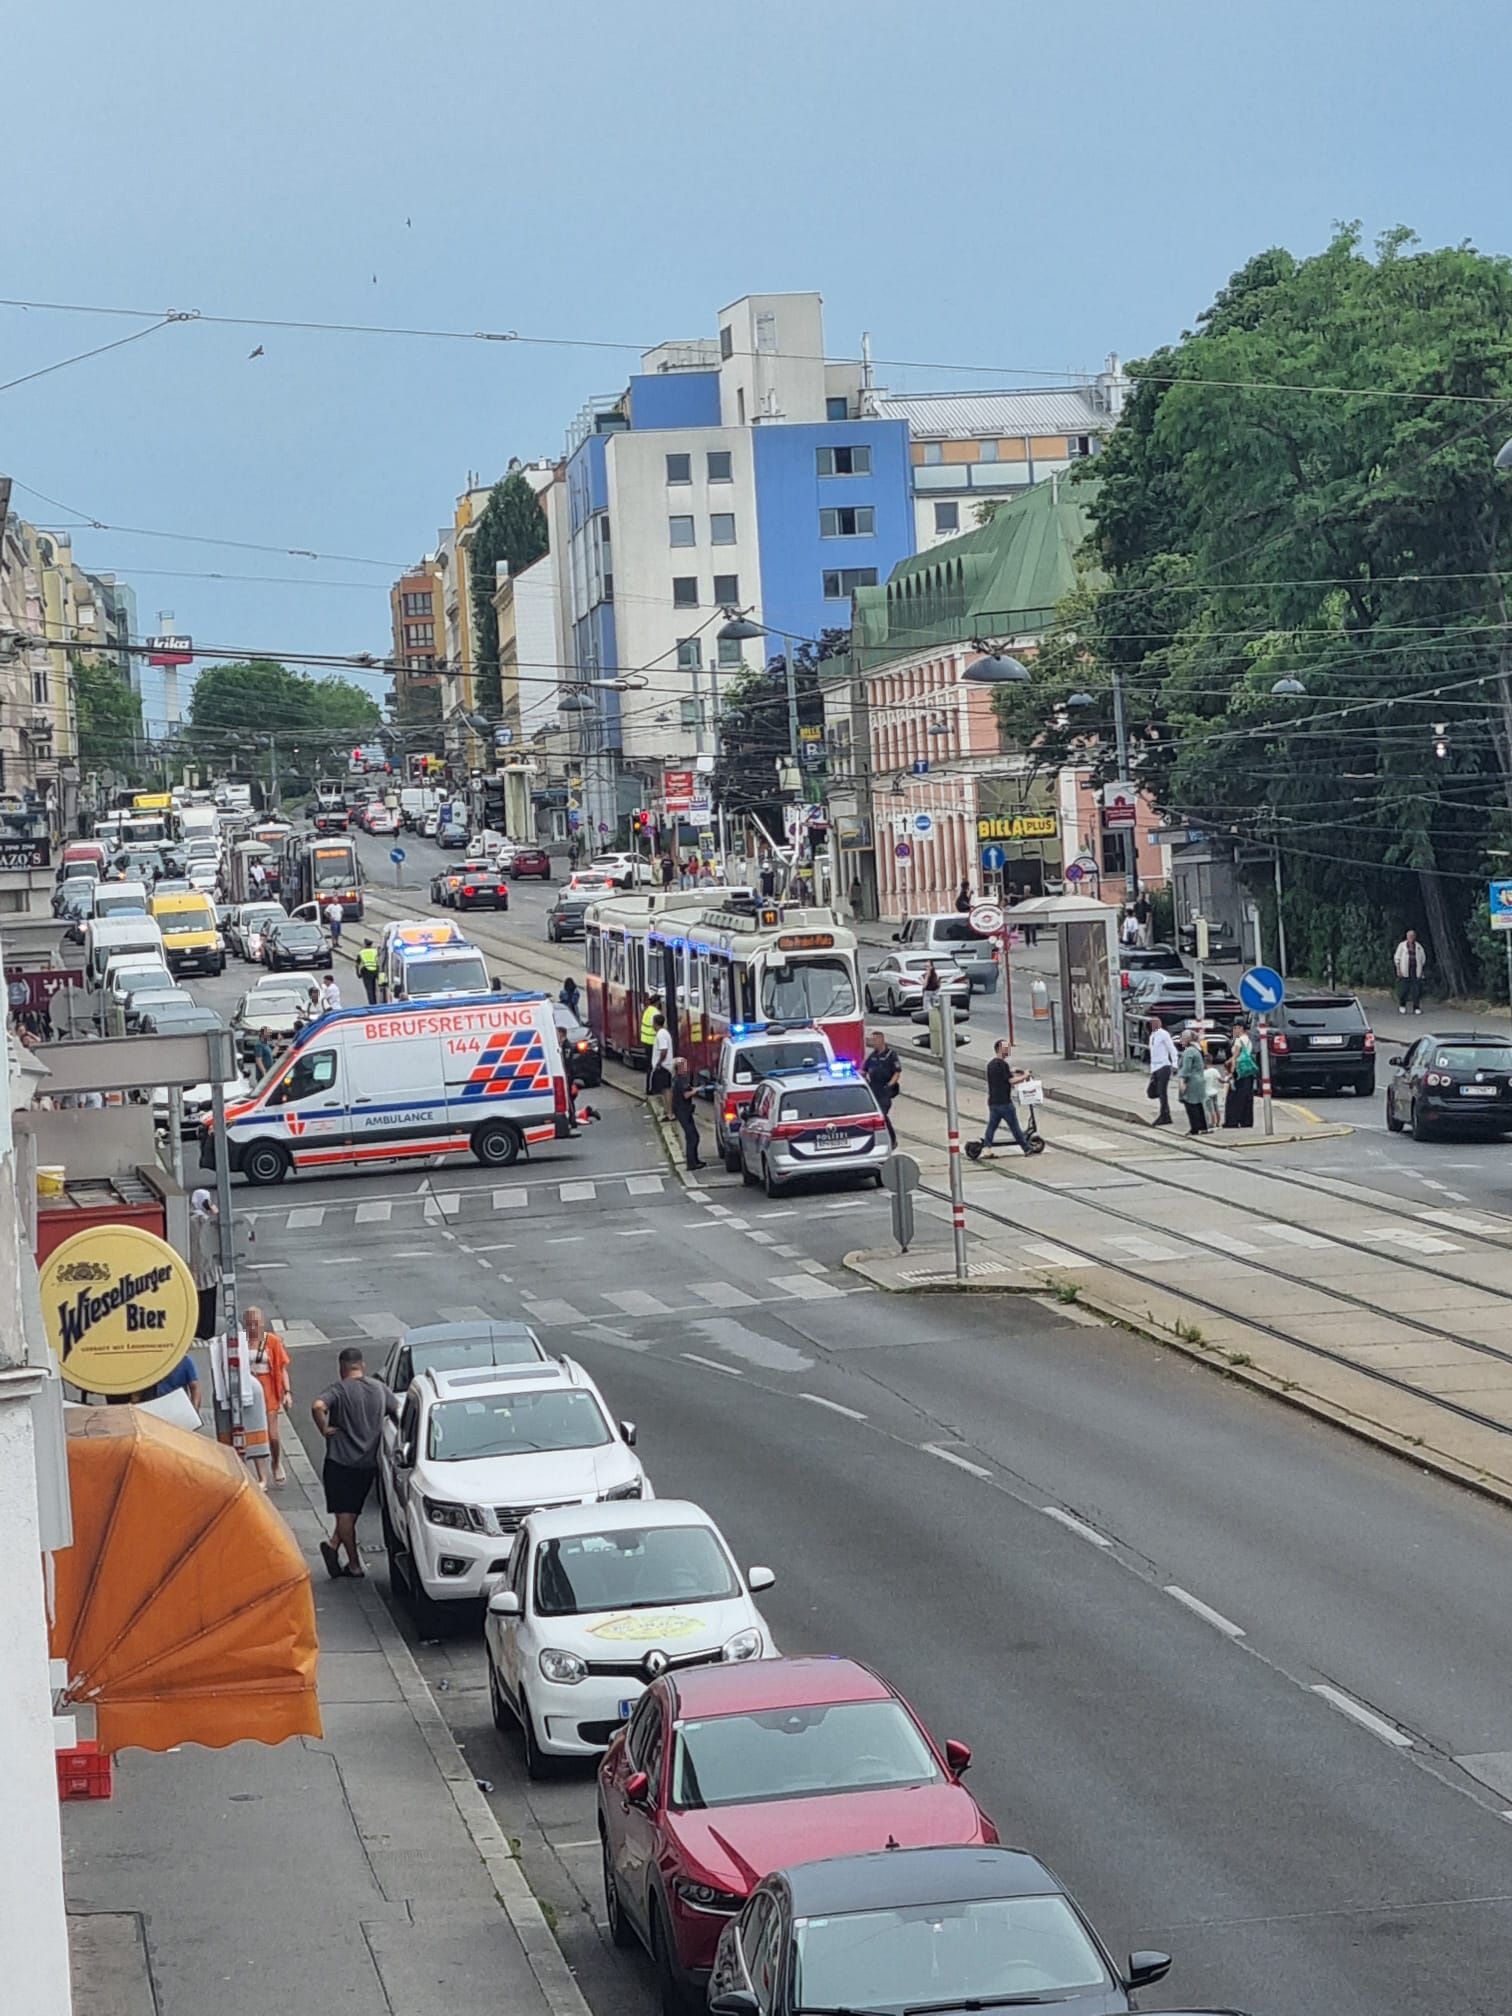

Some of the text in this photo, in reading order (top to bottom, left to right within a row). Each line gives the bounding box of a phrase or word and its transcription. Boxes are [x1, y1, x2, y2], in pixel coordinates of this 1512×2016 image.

[978, 818, 1051, 838] BILLA PLUS
[365, 1009, 533, 1040] BERUFSRETTUNG
[447, 1037, 481, 1055] 144
[365, 1111, 434, 1126] AMBULANCE
[57, 1264, 173, 1364] Wieselburger
[126, 1303, 167, 1332] Bier
